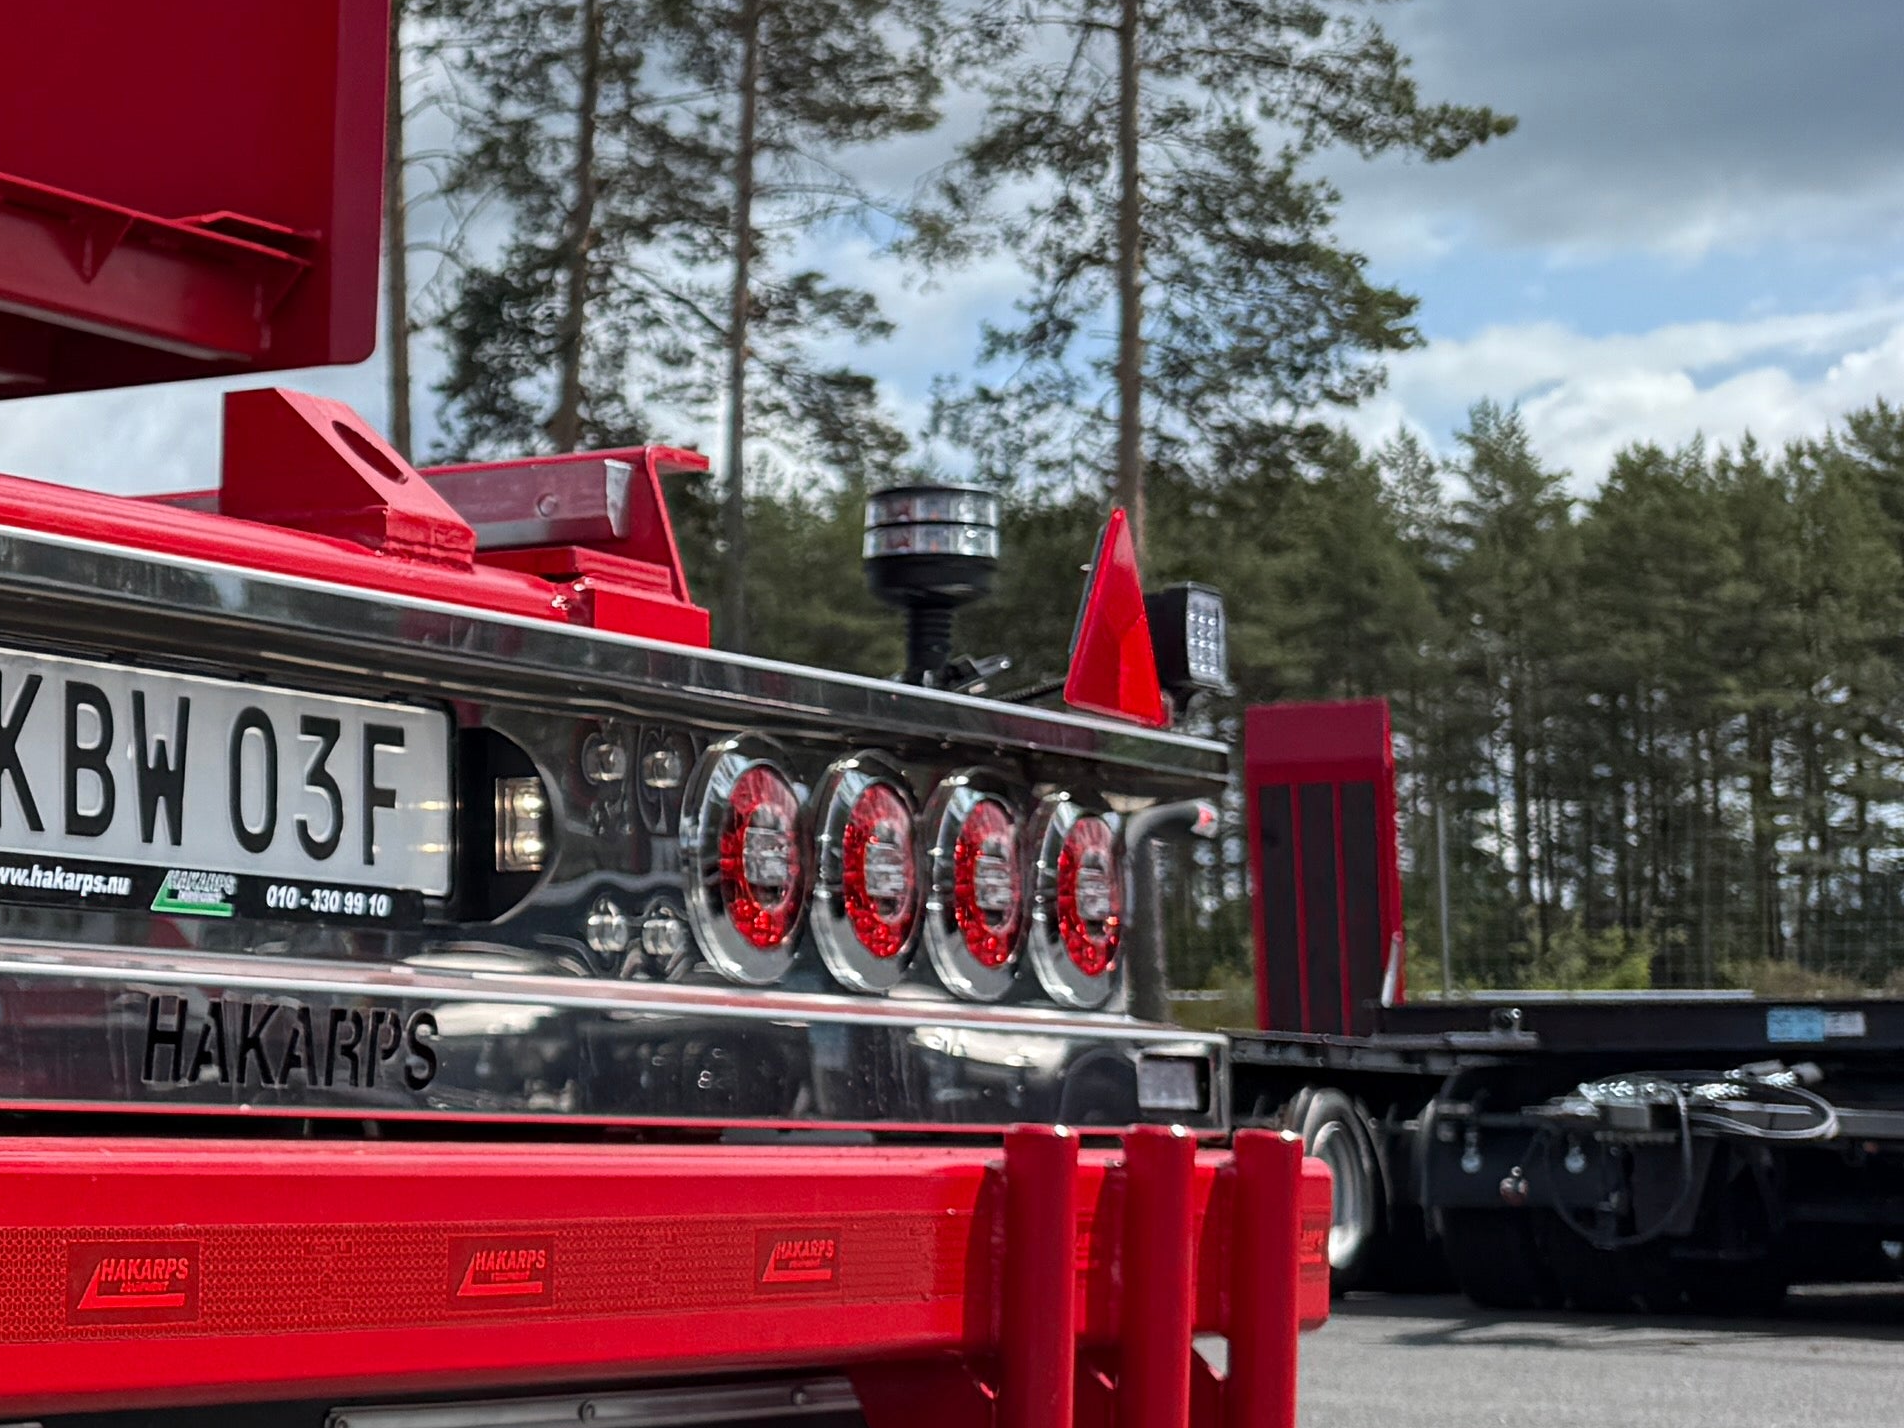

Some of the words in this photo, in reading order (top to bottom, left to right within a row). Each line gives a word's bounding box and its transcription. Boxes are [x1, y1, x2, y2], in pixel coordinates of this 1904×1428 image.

[229, 706, 406, 866] 03F
[343, 892, 367, 915] 99
[368, 893, 393, 917] 10
[142, 995, 439, 1090] HAKARPS
[101, 1257, 189, 1281] HAKARPS
[476, 1249, 546, 1270] HAKARPS
